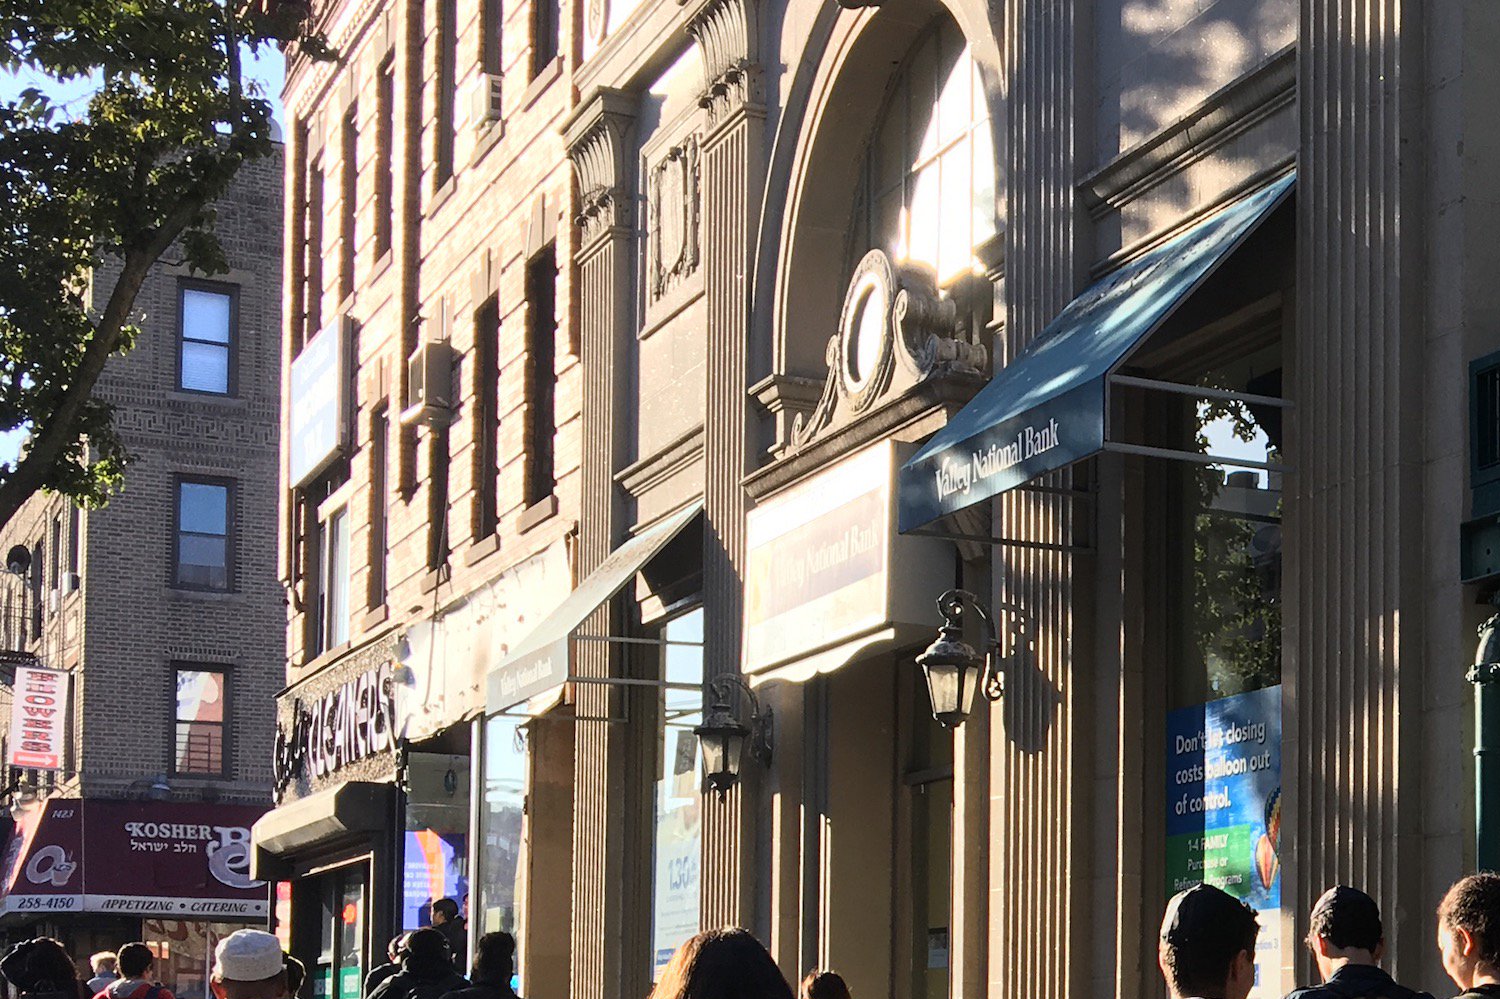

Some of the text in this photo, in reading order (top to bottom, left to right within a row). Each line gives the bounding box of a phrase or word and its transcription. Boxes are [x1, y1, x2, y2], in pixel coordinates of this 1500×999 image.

[935, 417, 1060, 503] Valley National Bank
[807, 531, 850, 580] National
[851, 518, 879, 558] Bank
[21, 671, 59, 752] FLOWERS
[1176, 731, 1206, 754] Don't
[1226, 720, 1265, 743] closing
[1176, 750, 1270, 784] costs balloon out
[1175, 786, 1231, 815] of control.
[52, 809, 74, 818] 1423
[125, 822, 213, 840] KOSHER
[130, 839, 168, 852] ישראל
[1174, 877, 1204, 891] Refinan
[18, 897, 74, 909] 258-4150
[101, 899, 248, 913] APPETIZING CATERING
